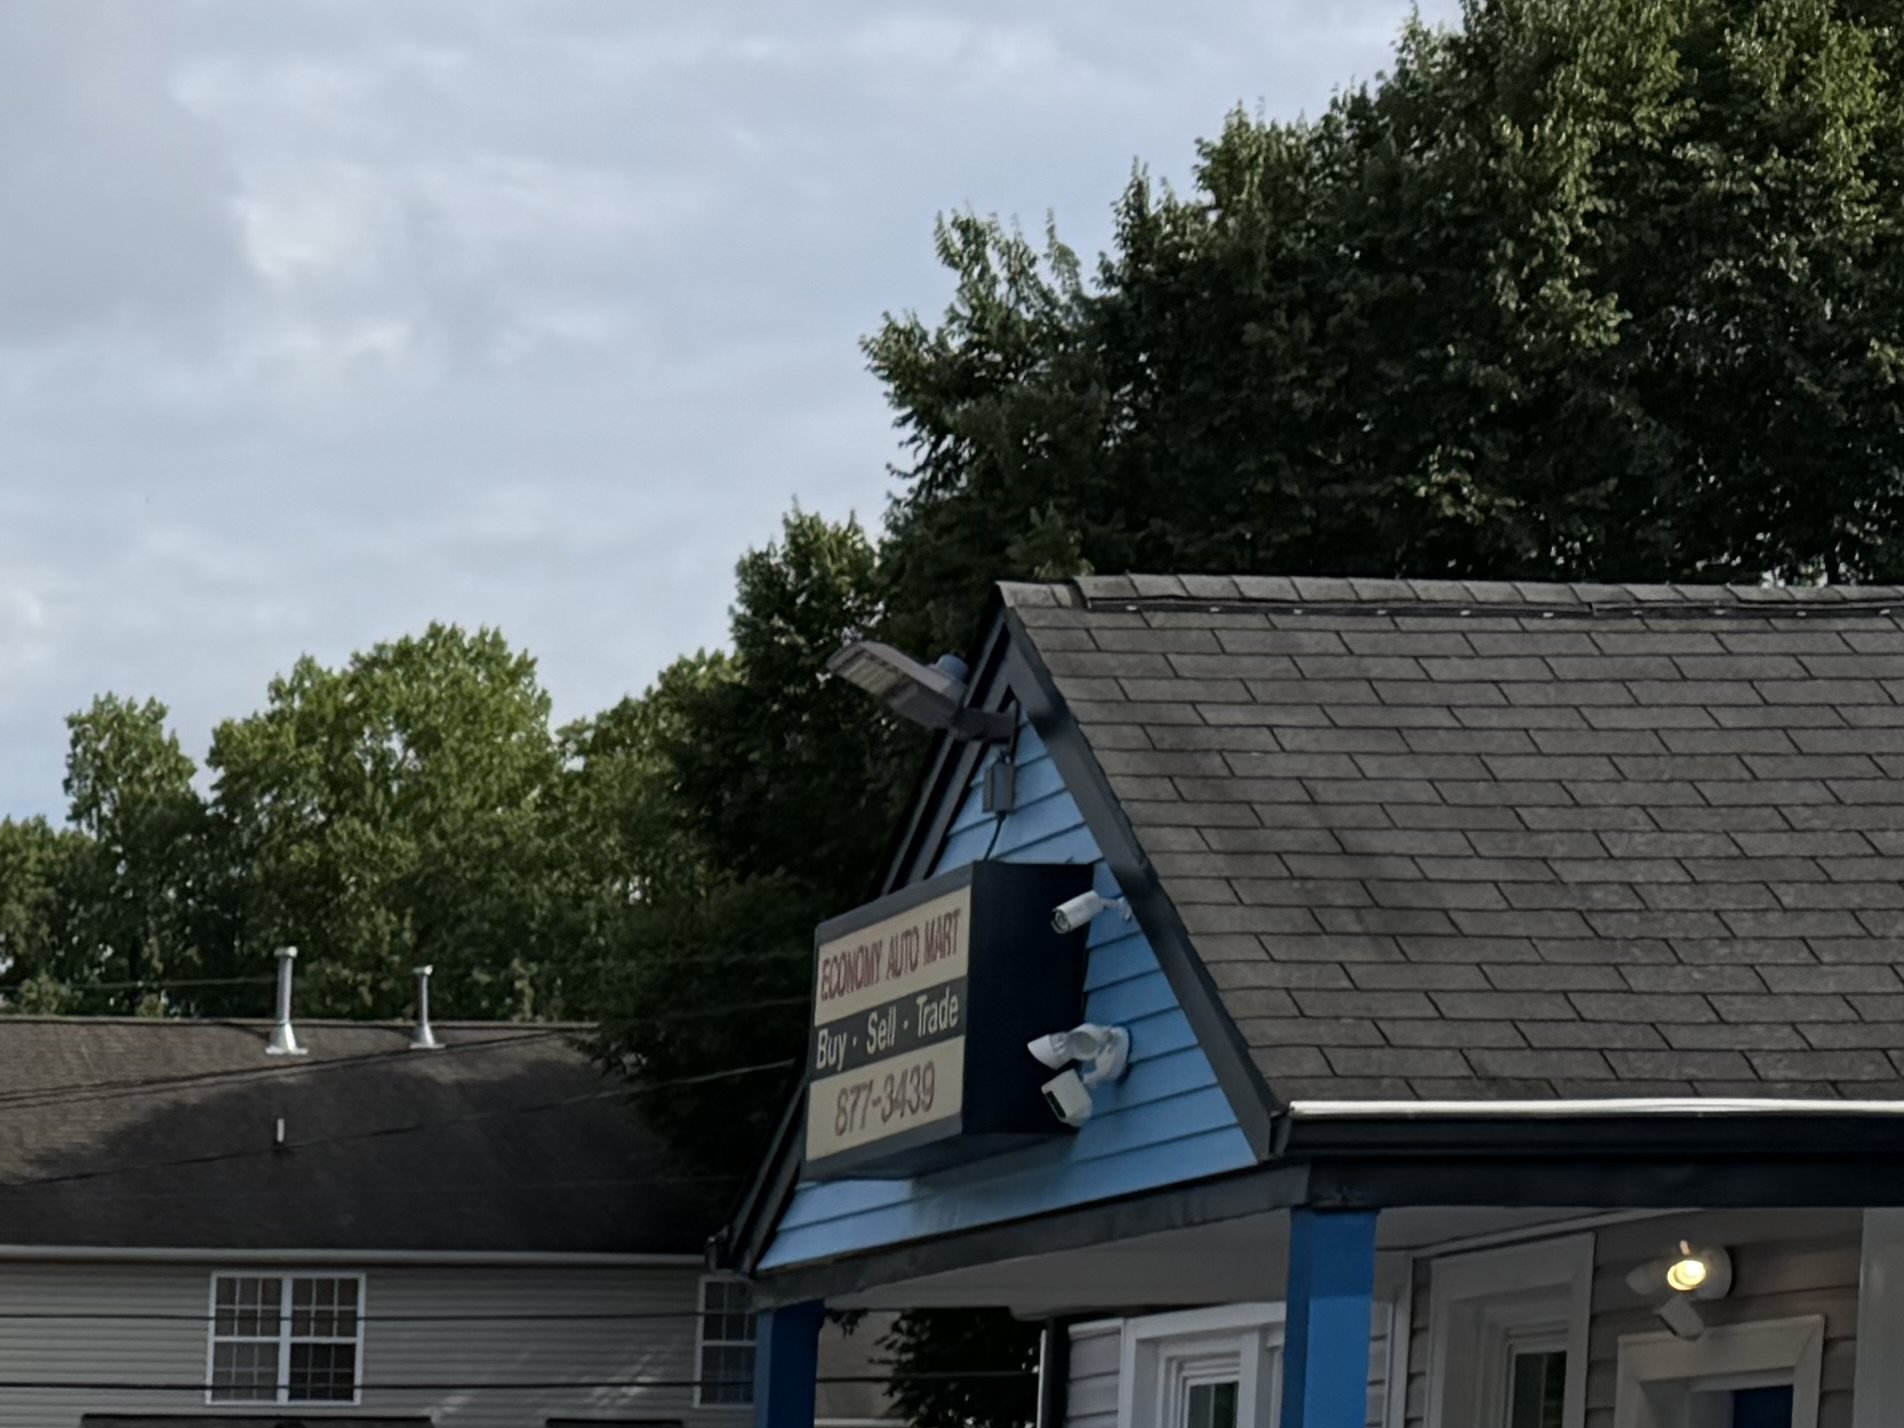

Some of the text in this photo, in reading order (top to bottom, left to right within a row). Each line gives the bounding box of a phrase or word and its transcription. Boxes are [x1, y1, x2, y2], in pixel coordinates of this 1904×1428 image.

[821, 909, 962, 1001] ECONOMY AUTO MART
[817, 987, 959, 1071] Buy Sell Trade
[834, 1061, 936, 1137] 877-3439
